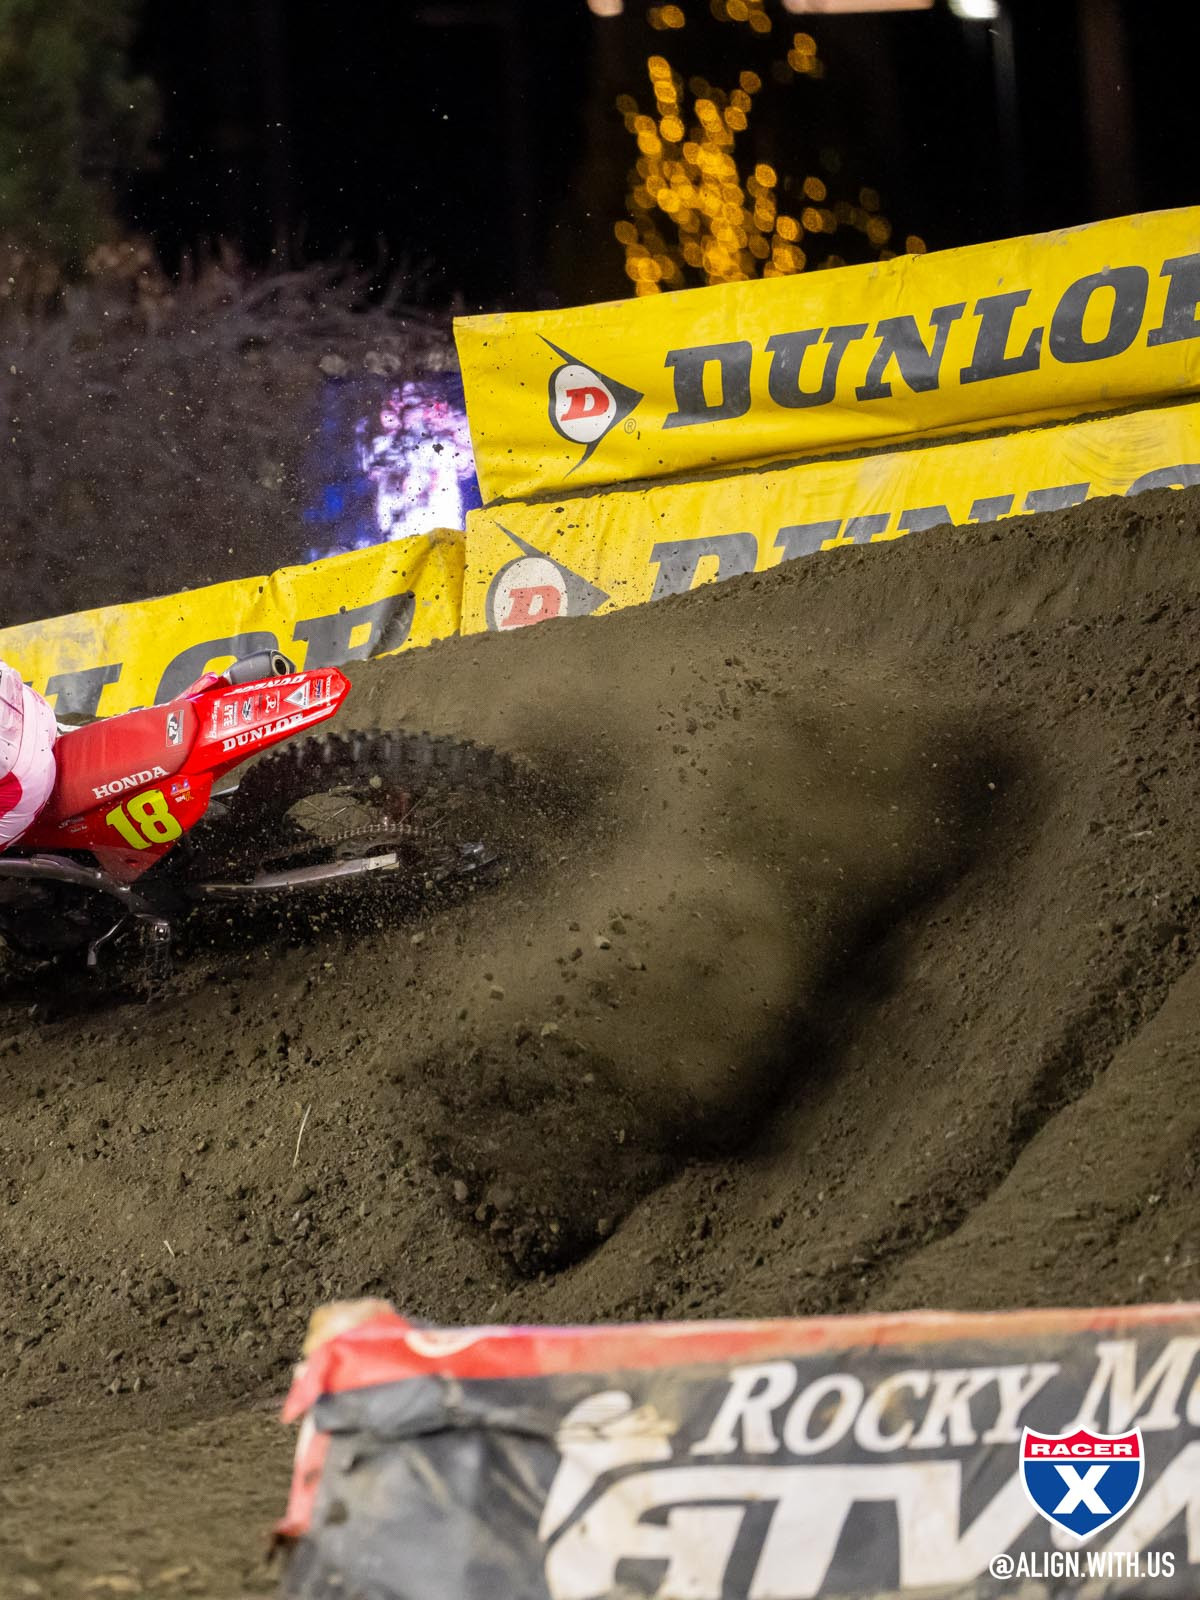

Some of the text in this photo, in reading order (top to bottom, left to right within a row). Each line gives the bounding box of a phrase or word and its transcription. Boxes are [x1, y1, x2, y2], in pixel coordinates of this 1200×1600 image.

[222, 713, 304, 752] DUNLOP
[91, 766, 170, 800] HONDA
[105, 789, 182, 850] 18
[690, 1360, 1061, 1456] ROCKY
